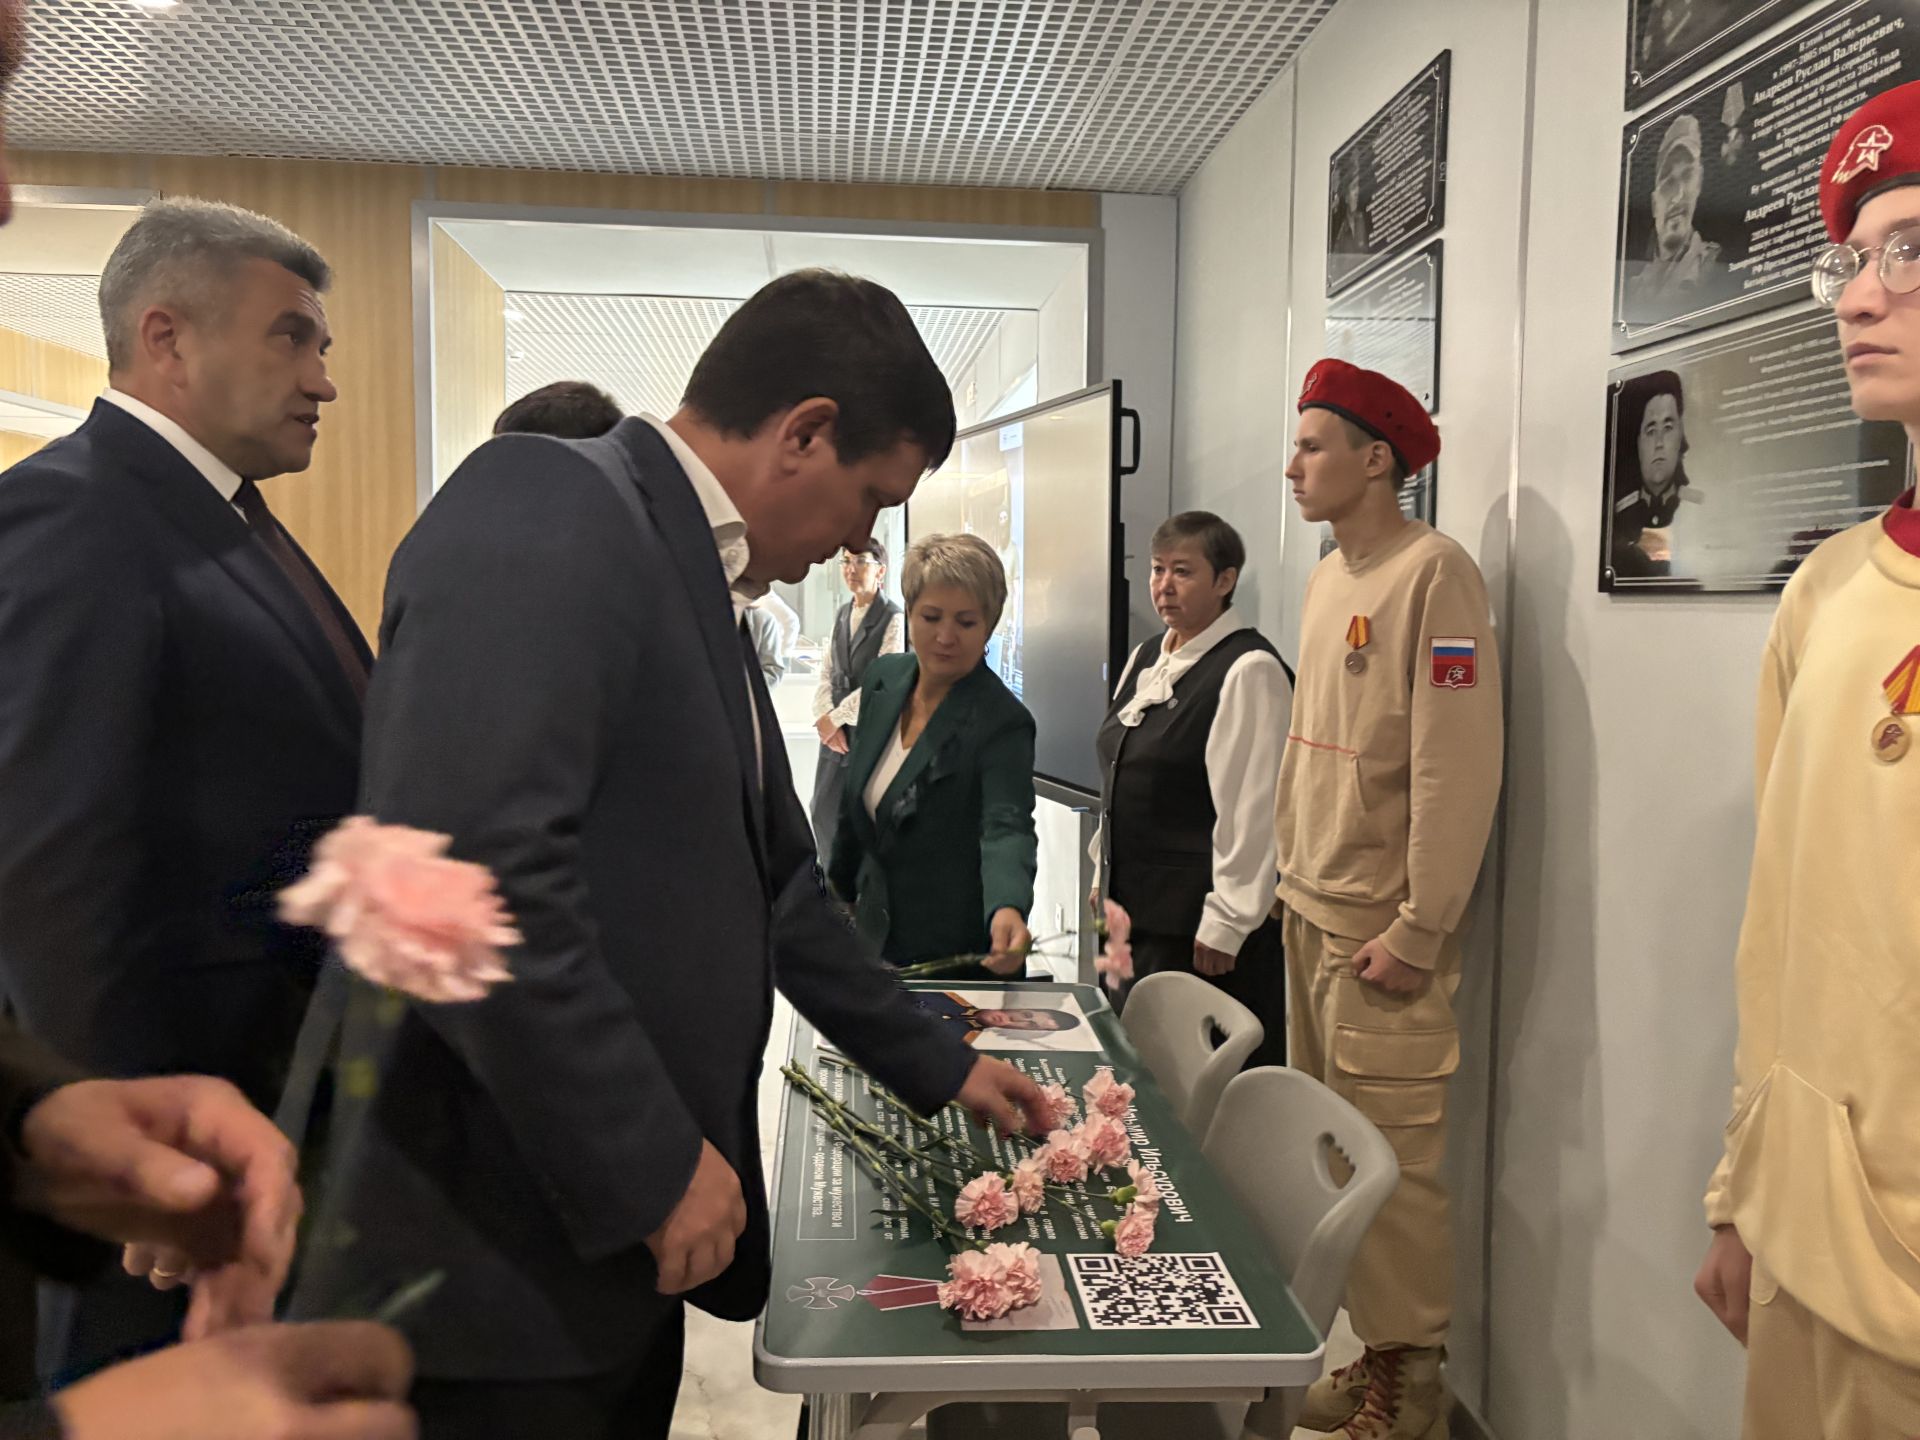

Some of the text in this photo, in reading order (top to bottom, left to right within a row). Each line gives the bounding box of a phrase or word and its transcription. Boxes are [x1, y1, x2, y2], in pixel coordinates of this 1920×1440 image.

[1753, 17, 1904, 104] Андреев Руслан Валерьевич,
[1744, 198, 1784, 222] Андреев
[812, 1152, 826, 1180] орденом
[831, 1141, 845, 1176] Федерации
[810, 1181, 827, 1218] Мужества.
[1138, 1148, 1192, 1222] Ильсурович
[829, 1187, 843, 1220] мужество
